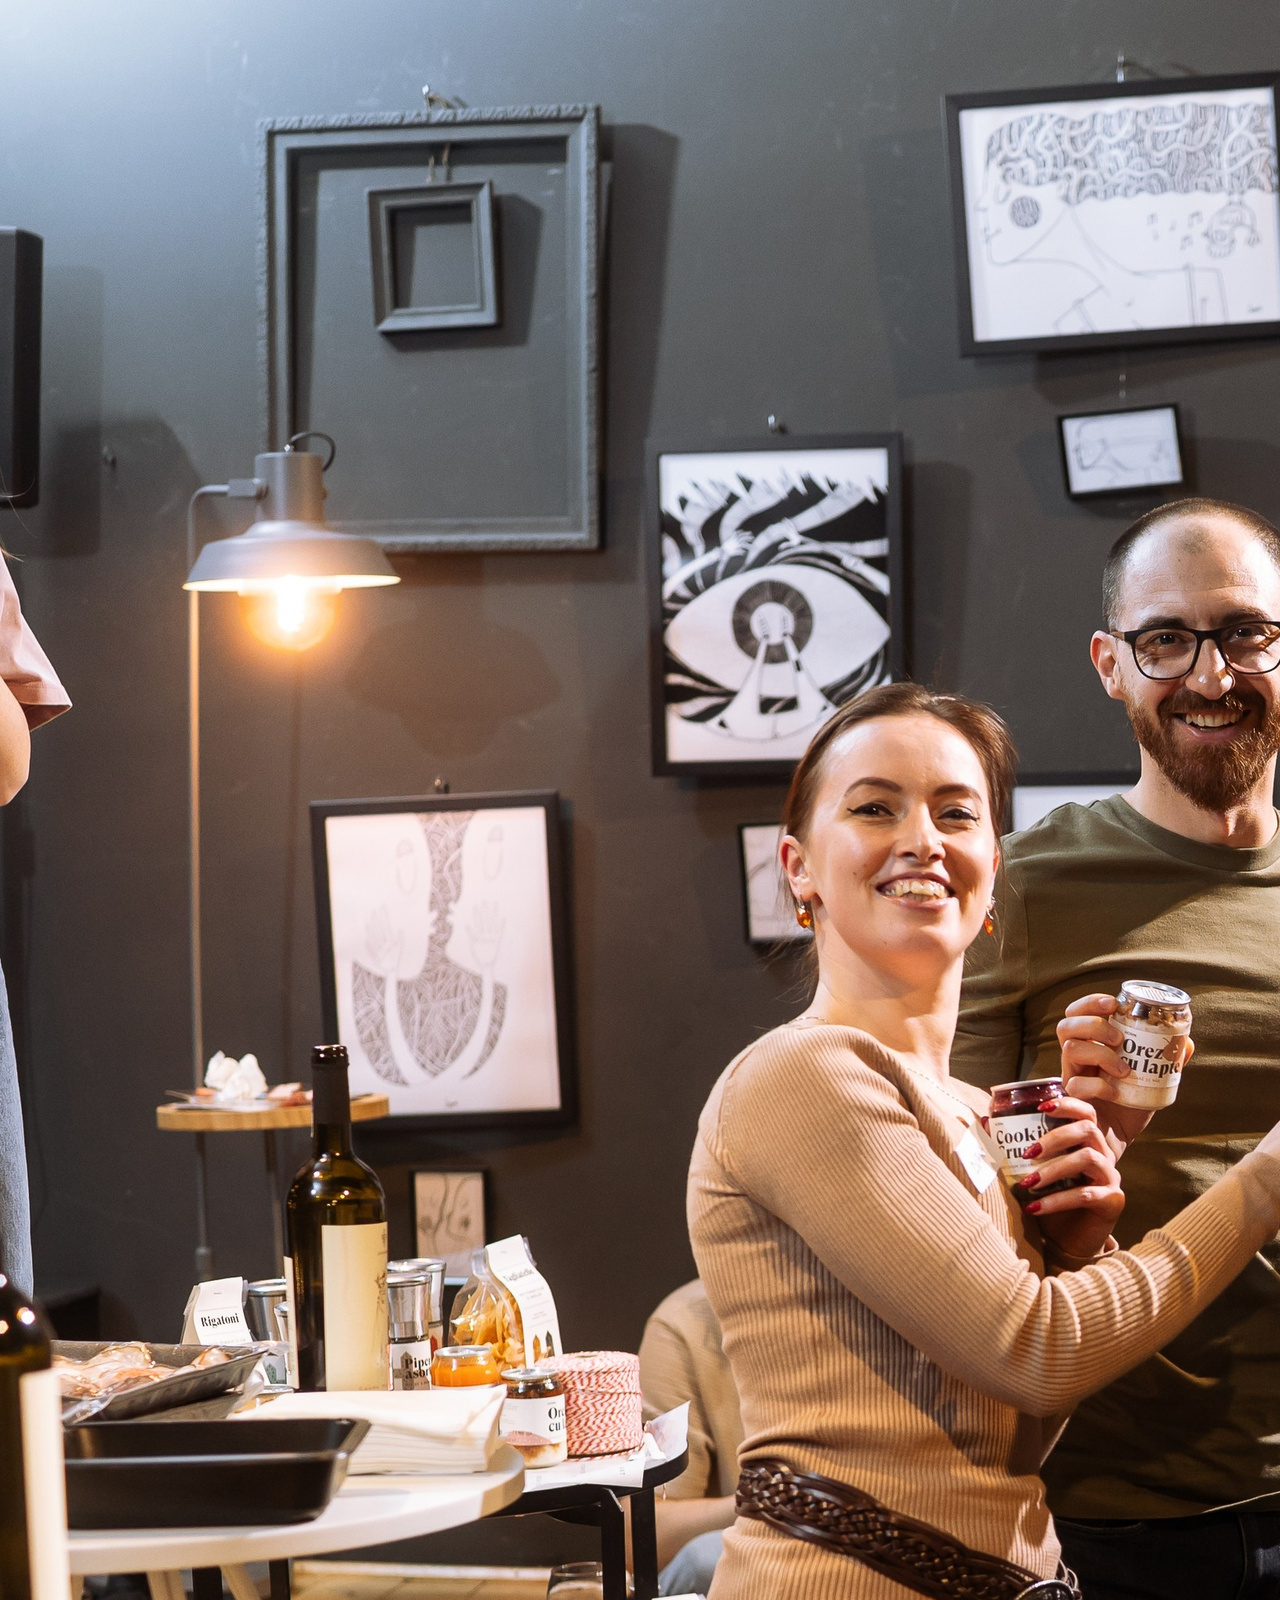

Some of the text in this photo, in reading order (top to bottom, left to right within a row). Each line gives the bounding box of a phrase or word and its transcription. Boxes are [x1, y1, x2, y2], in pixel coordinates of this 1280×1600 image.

[1122, 1038, 1164, 1060] Orez
[1142, 1059, 1180, 1078] lapte
[996, 1126, 1048, 1145] Cooki
[200, 1313, 240, 1328] Rigatoni
